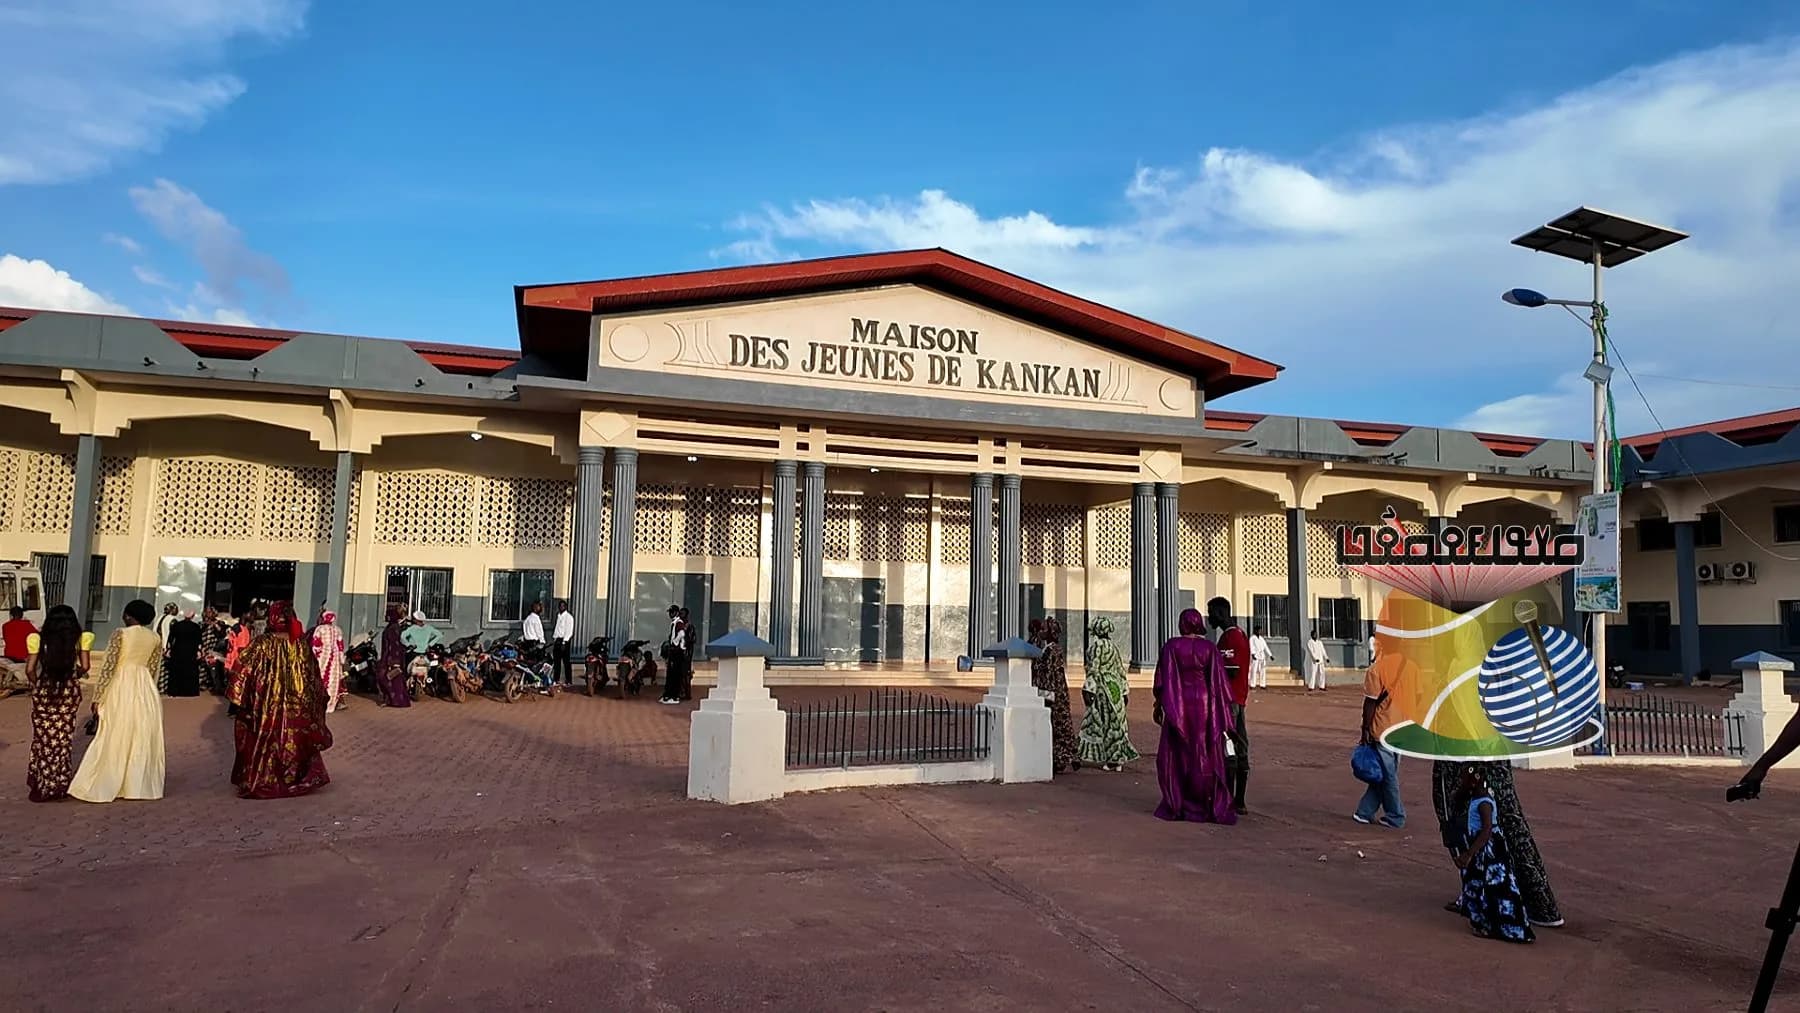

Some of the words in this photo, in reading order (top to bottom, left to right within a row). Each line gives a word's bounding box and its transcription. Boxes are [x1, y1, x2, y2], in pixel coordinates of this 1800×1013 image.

[851, 318, 979, 354] MAISON
[729, 334, 789, 370] DES
[801, 342, 914, 382] JEUNES
[928, 354, 962, 387] DE
[976, 358, 1101, 398] KANKAN
